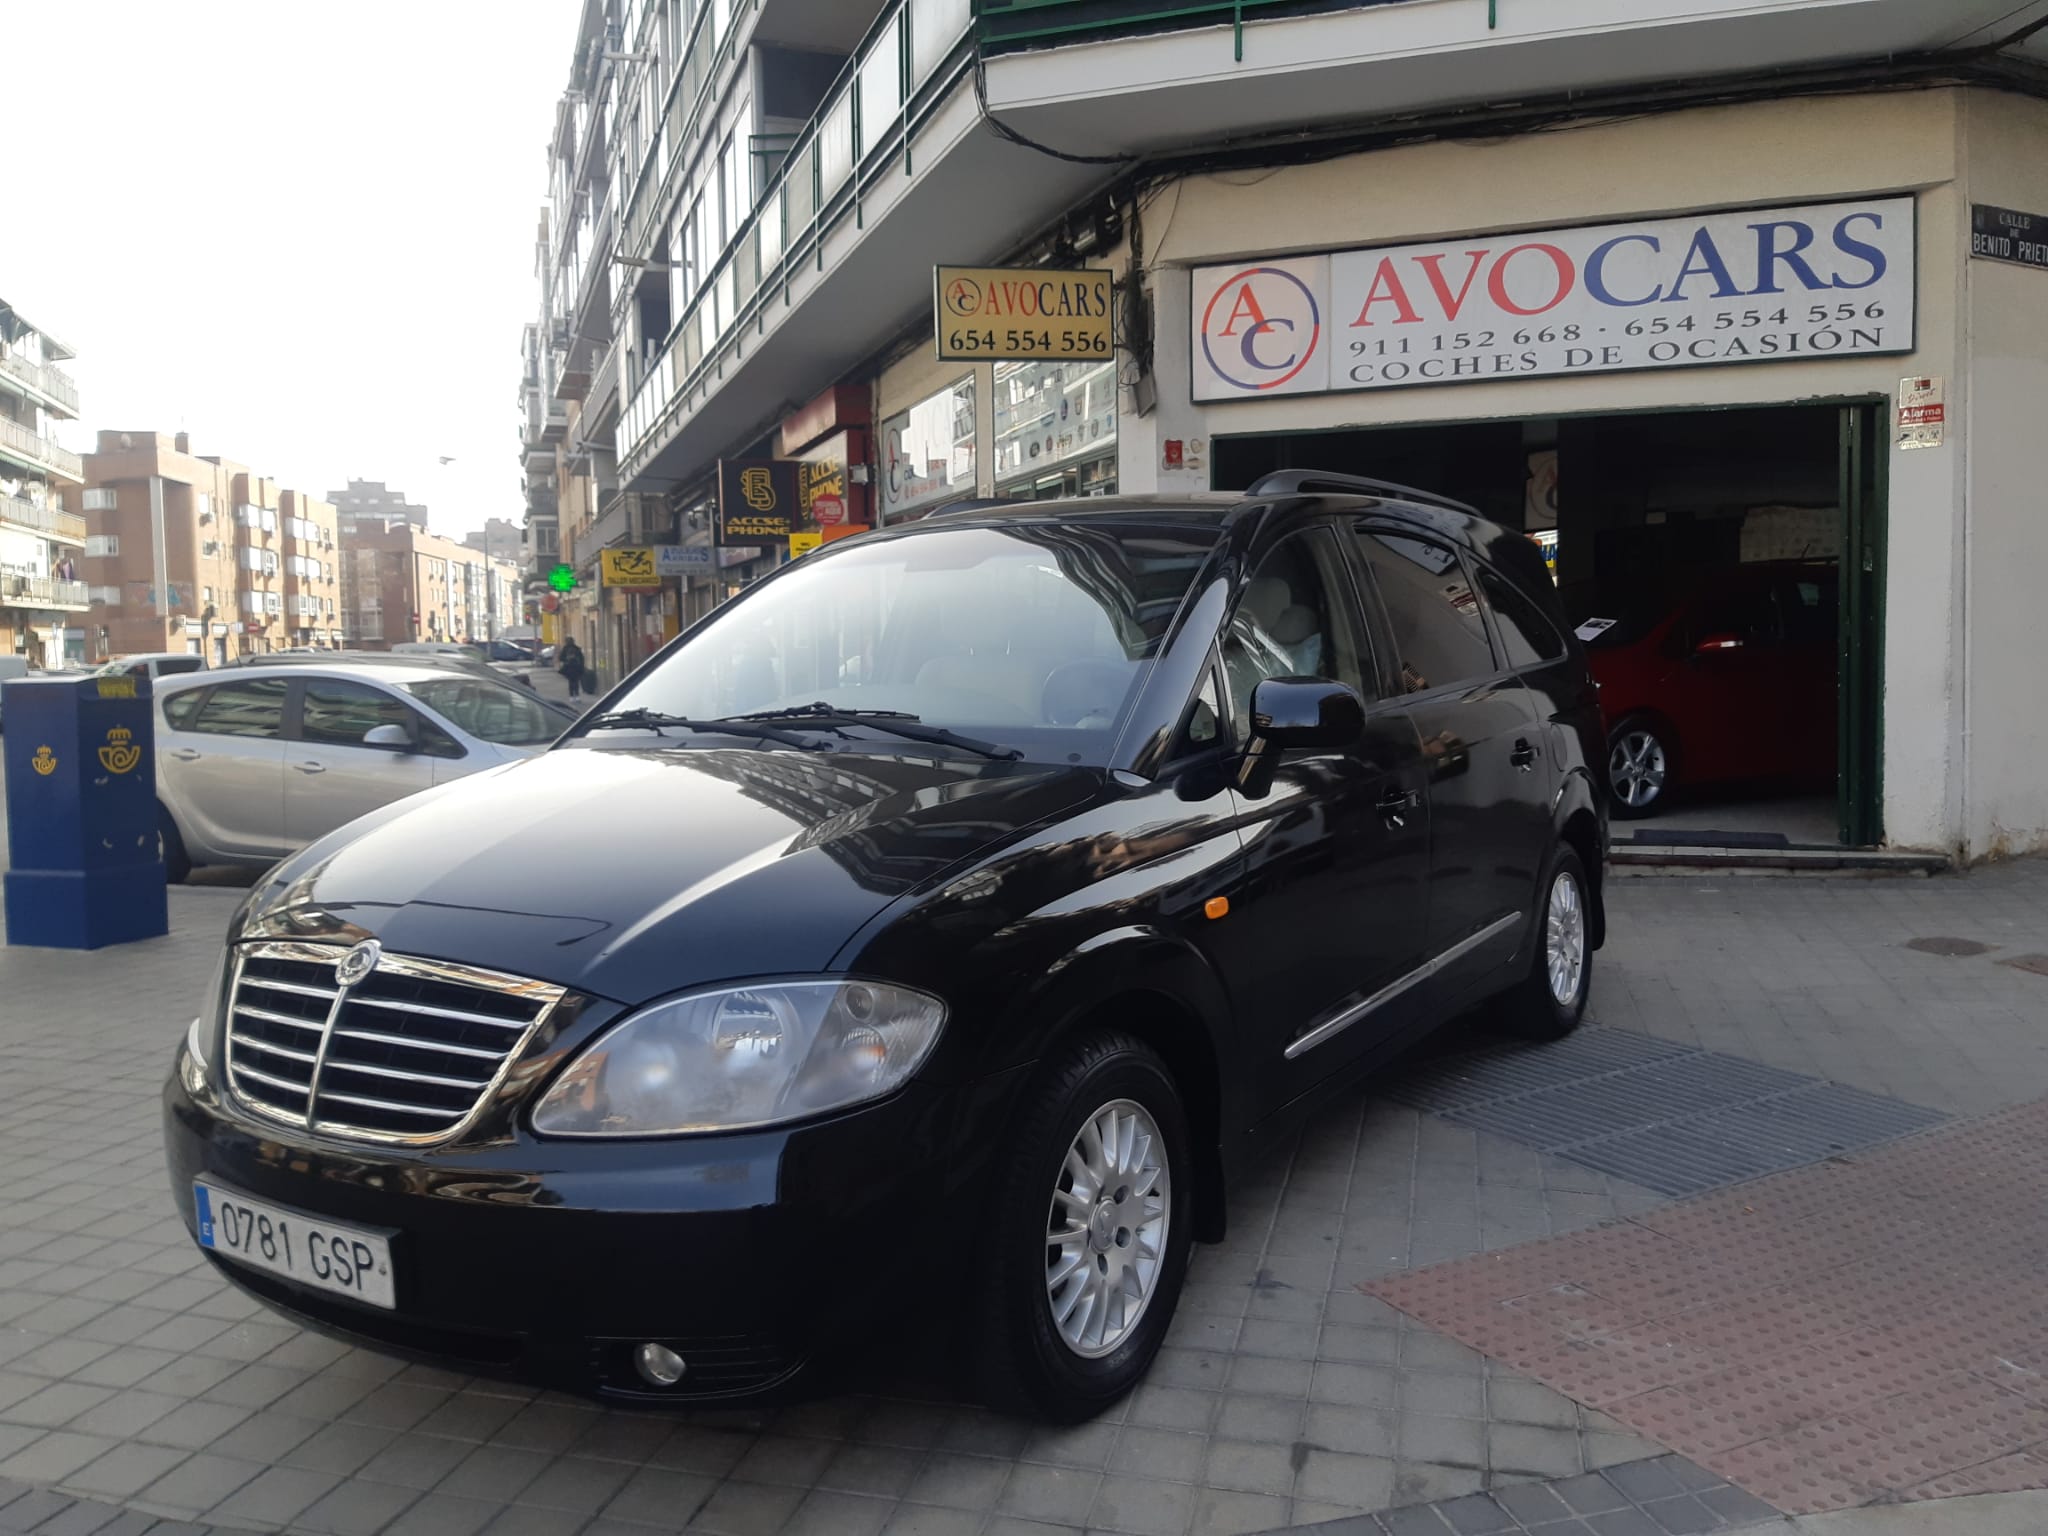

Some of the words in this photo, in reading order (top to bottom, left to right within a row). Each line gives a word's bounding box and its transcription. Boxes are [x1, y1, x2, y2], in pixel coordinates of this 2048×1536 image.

[1999, 212, 2031, 230] CALLE
[2009, 227, 2020, 238] DE
[1973, 232, 2011, 257] BENITO
[1349, 212, 1888, 327] AVOCARS
[985, 280, 1107, 318] AVOCARS
[949, 329, 996, 351] 654
[1005, 330, 1052, 351] 554
[1061, 331, 1107, 352] 556
[1349, 336, 1411, 358] 911
[1431, 330, 1495, 350] 152
[1512, 323, 1581, 345] 668
[1624, 315, 1697, 337] 654
[1713, 307, 1789, 330] 554
[1807, 300, 1885, 324] 556
[1349, 350, 1539, 384] COCHES
[1563, 345, 1624, 368] DE
[1647, 324, 1886, 363] OCASIÓN
[1901, 407, 1942, 419] Alarma
[727, 526, 791, 536] PHONE
[221, 1201, 292, 1272] 0781
[308, 1230, 374, 1290] GSP
